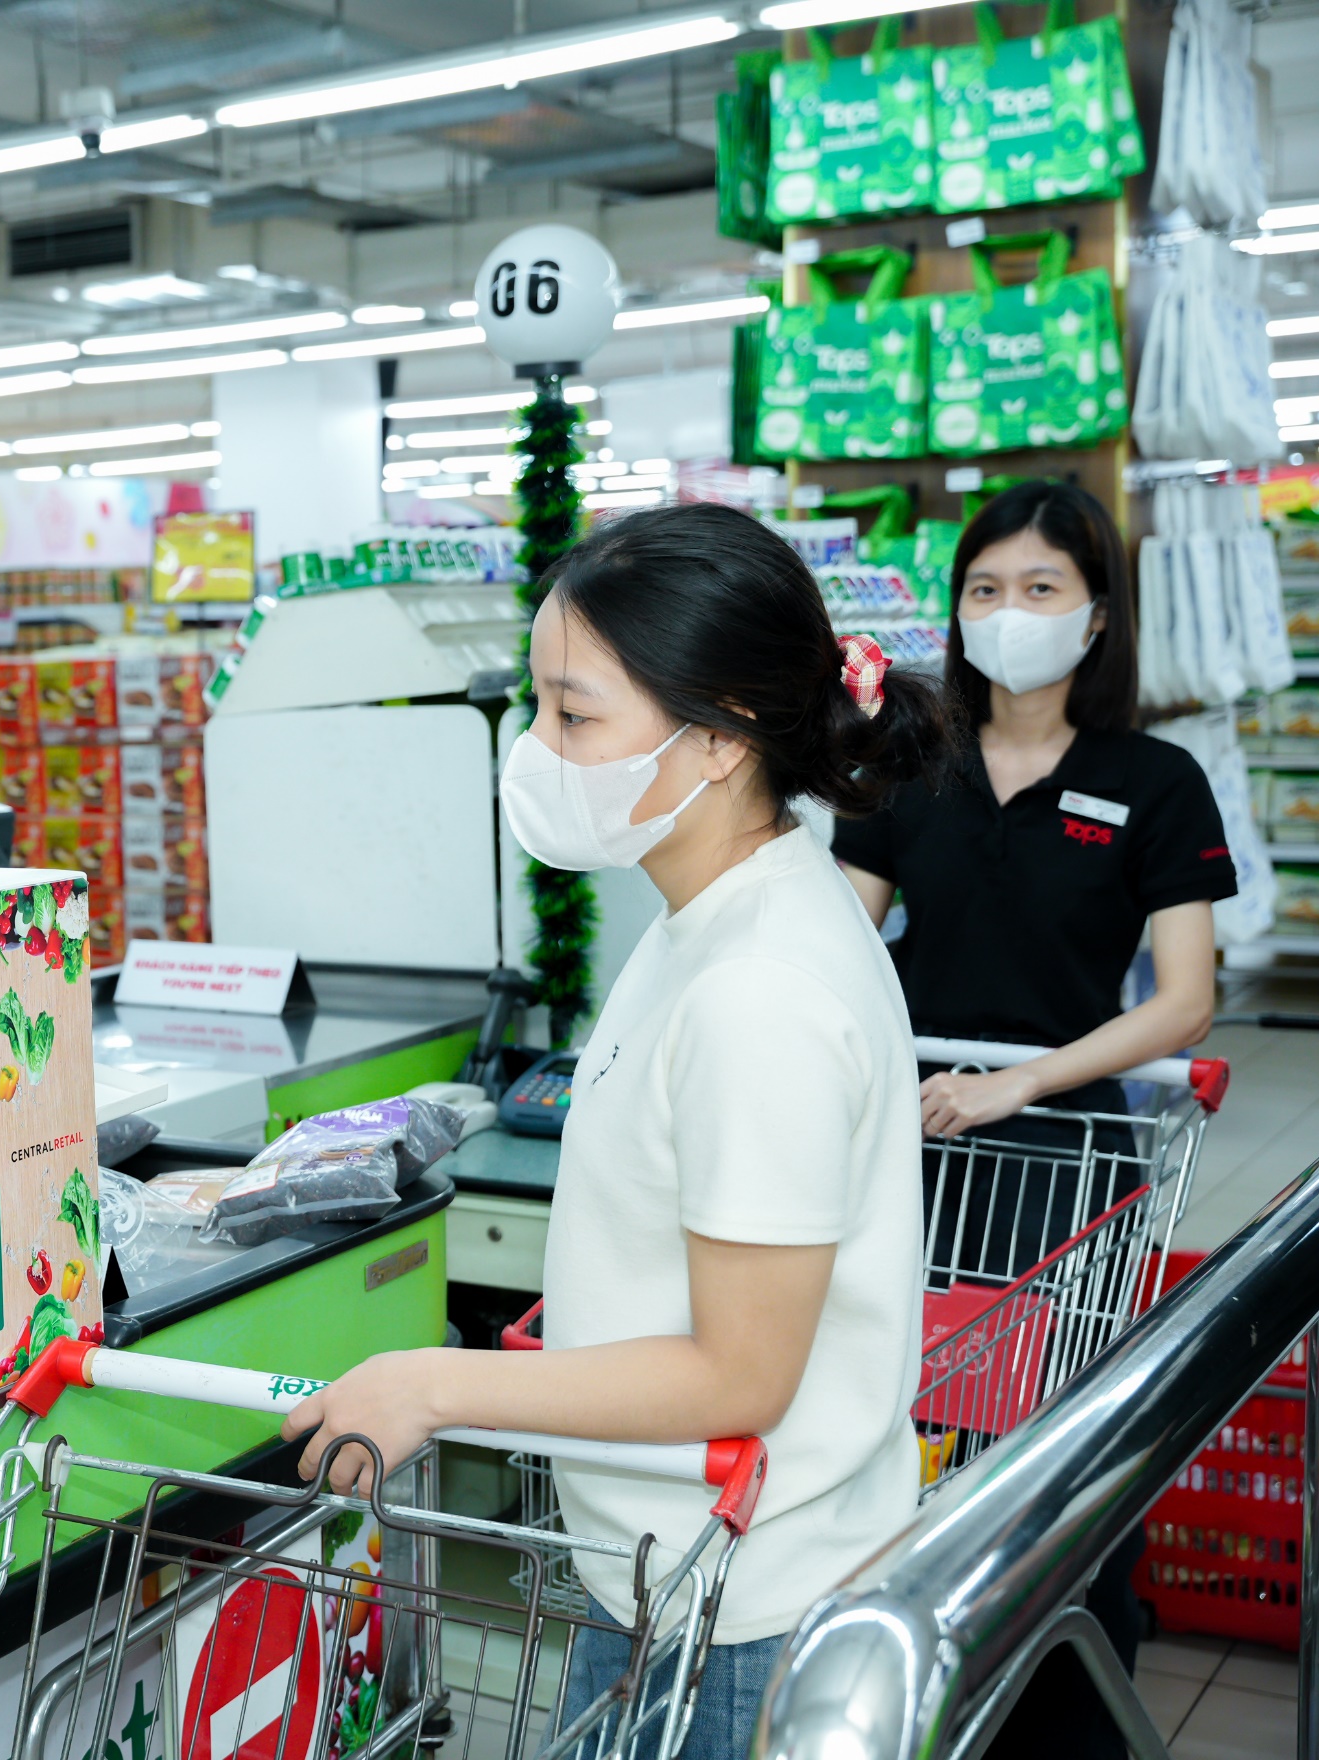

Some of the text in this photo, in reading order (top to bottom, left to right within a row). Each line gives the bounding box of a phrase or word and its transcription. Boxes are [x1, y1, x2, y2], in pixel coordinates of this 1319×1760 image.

[819, 98, 878, 134] Tops
[987, 83, 1050, 120] Tops
[491, 260, 559, 317] 06
[1061, 817, 1114, 846] Tops
